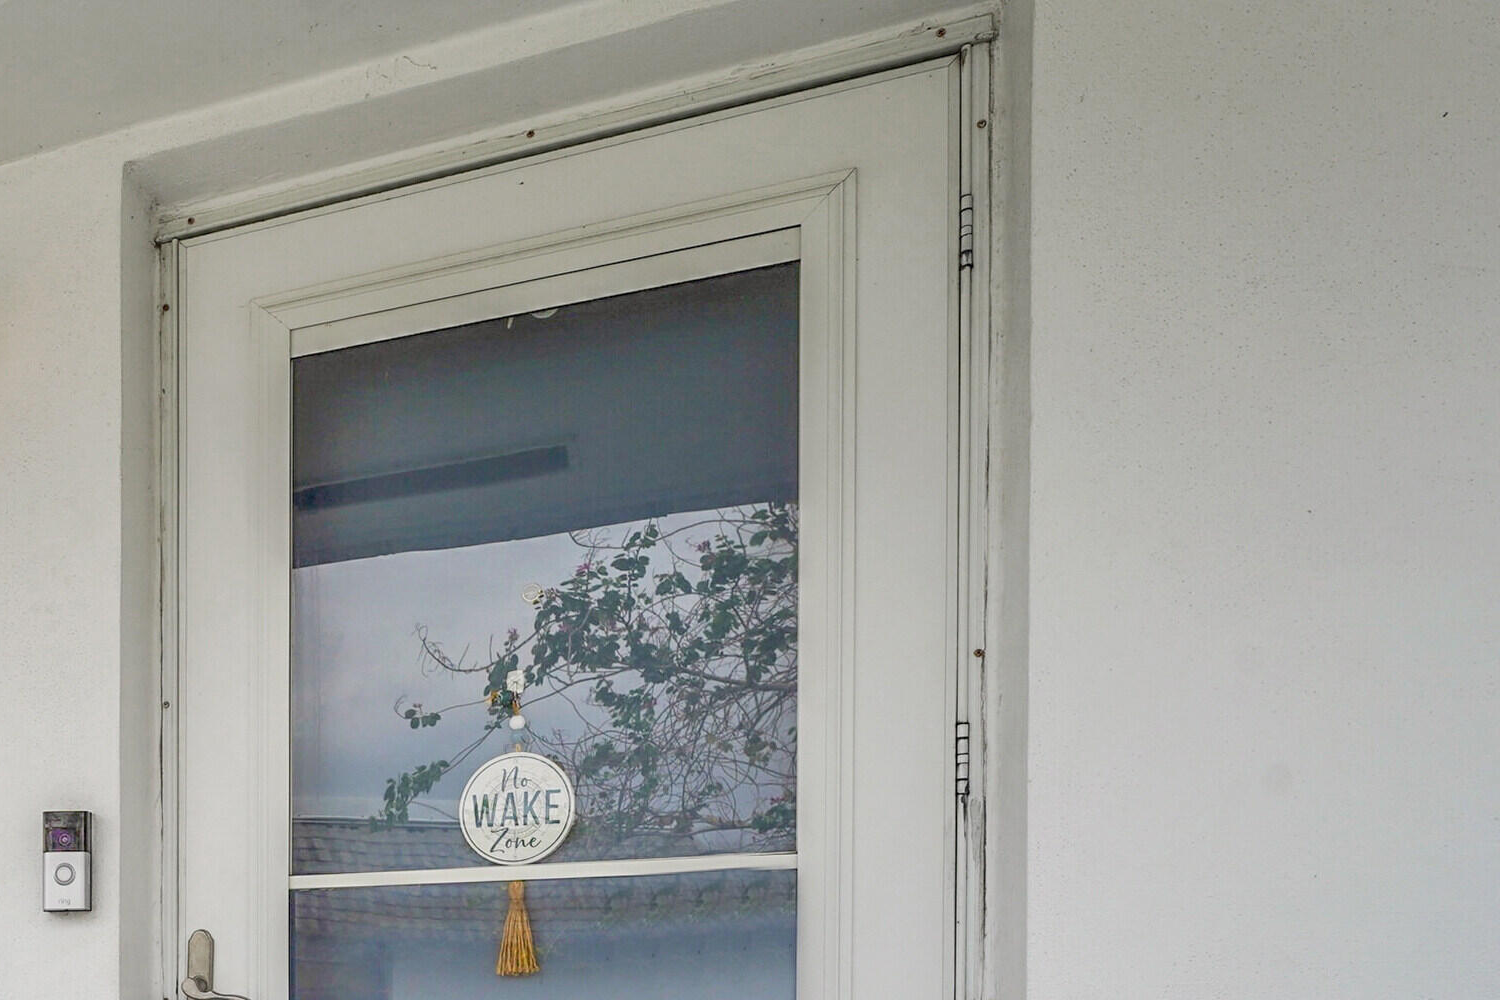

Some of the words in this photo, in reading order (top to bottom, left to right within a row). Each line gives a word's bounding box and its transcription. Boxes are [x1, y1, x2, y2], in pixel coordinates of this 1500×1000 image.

[501, 766, 532, 792] No
[472, 789, 561, 828] WAKE
[489, 827, 542, 853] Zone
